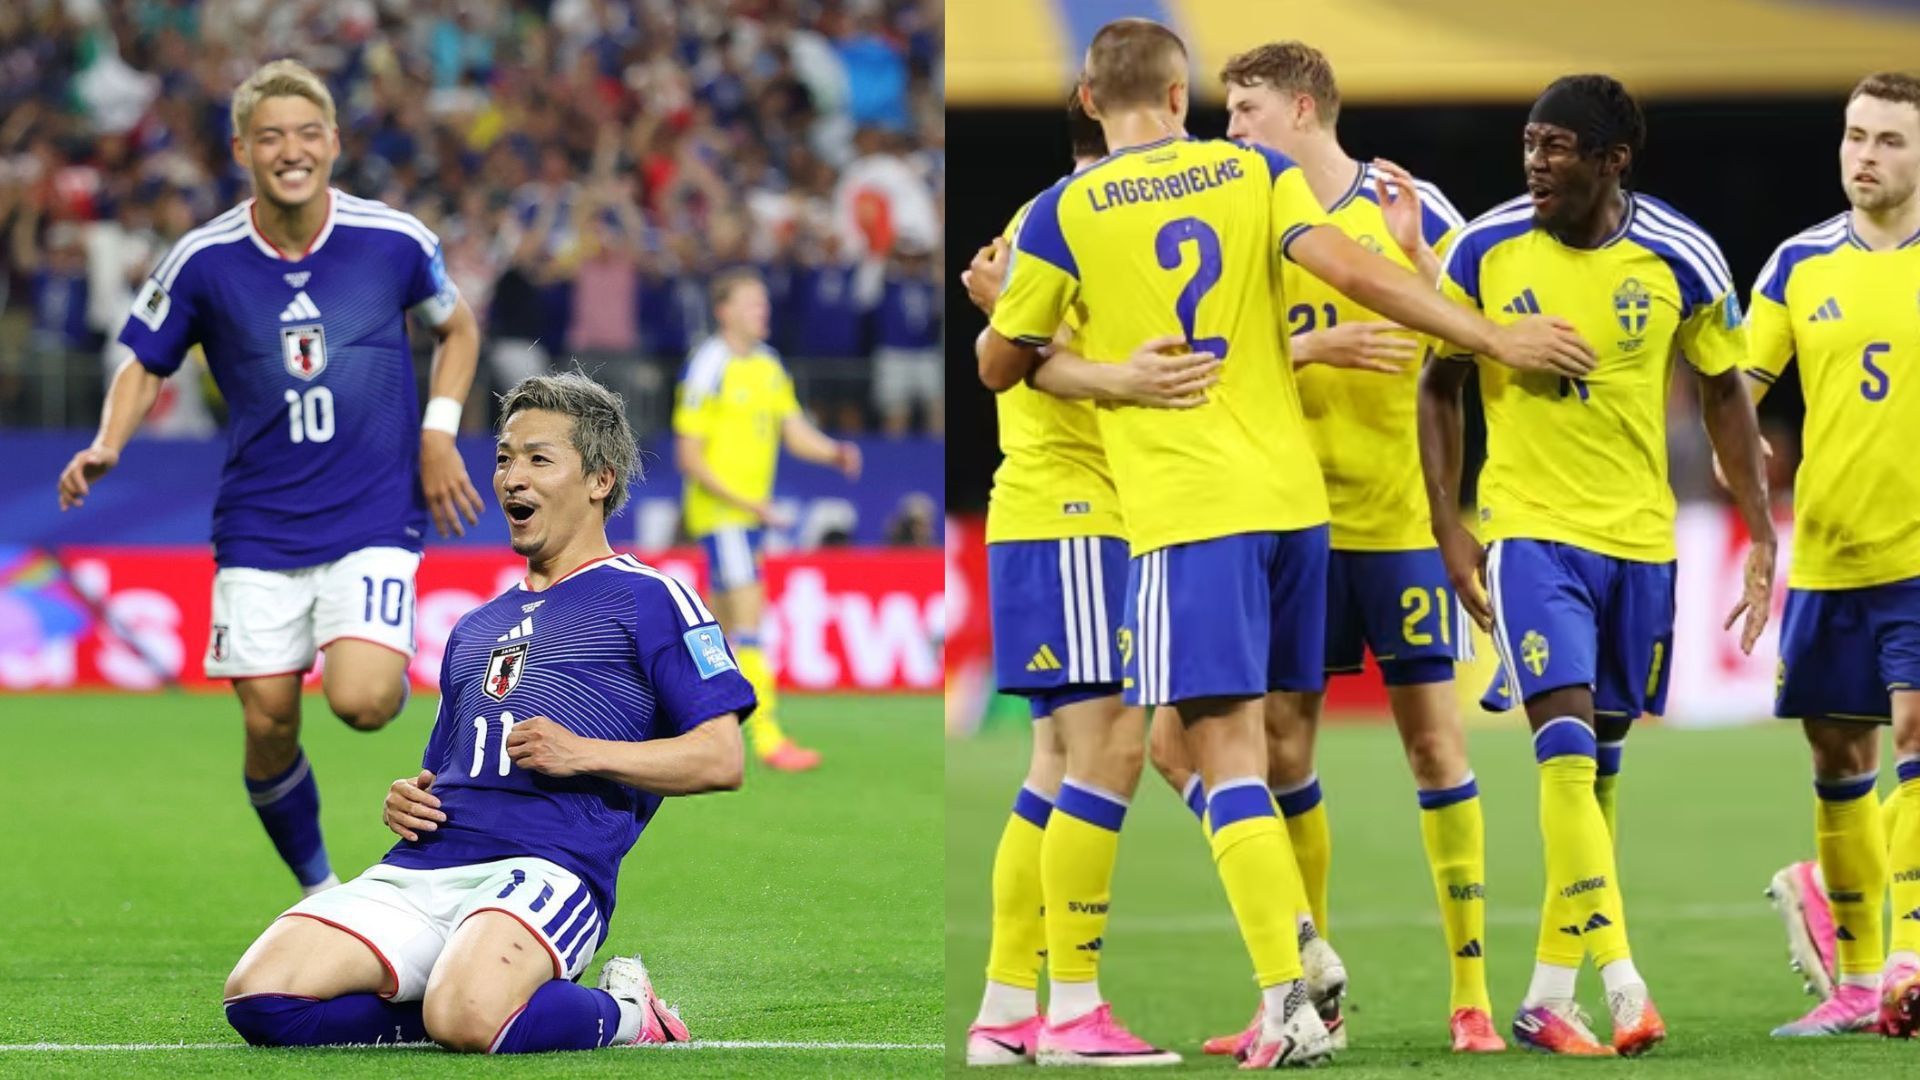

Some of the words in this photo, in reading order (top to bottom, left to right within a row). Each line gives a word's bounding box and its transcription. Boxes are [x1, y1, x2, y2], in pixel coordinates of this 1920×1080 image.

[1087, 158, 1244, 212] LAGERBIELKE
[1155, 217, 1228, 359] 2
[1861, 342, 1890, 401] 5
[284, 386, 336, 443] 10
[362, 576, 404, 626] 10
[1401, 587, 1450, 645] 21
[500, 646, 521, 655] JAPAN
[470, 711, 514, 778] 11
